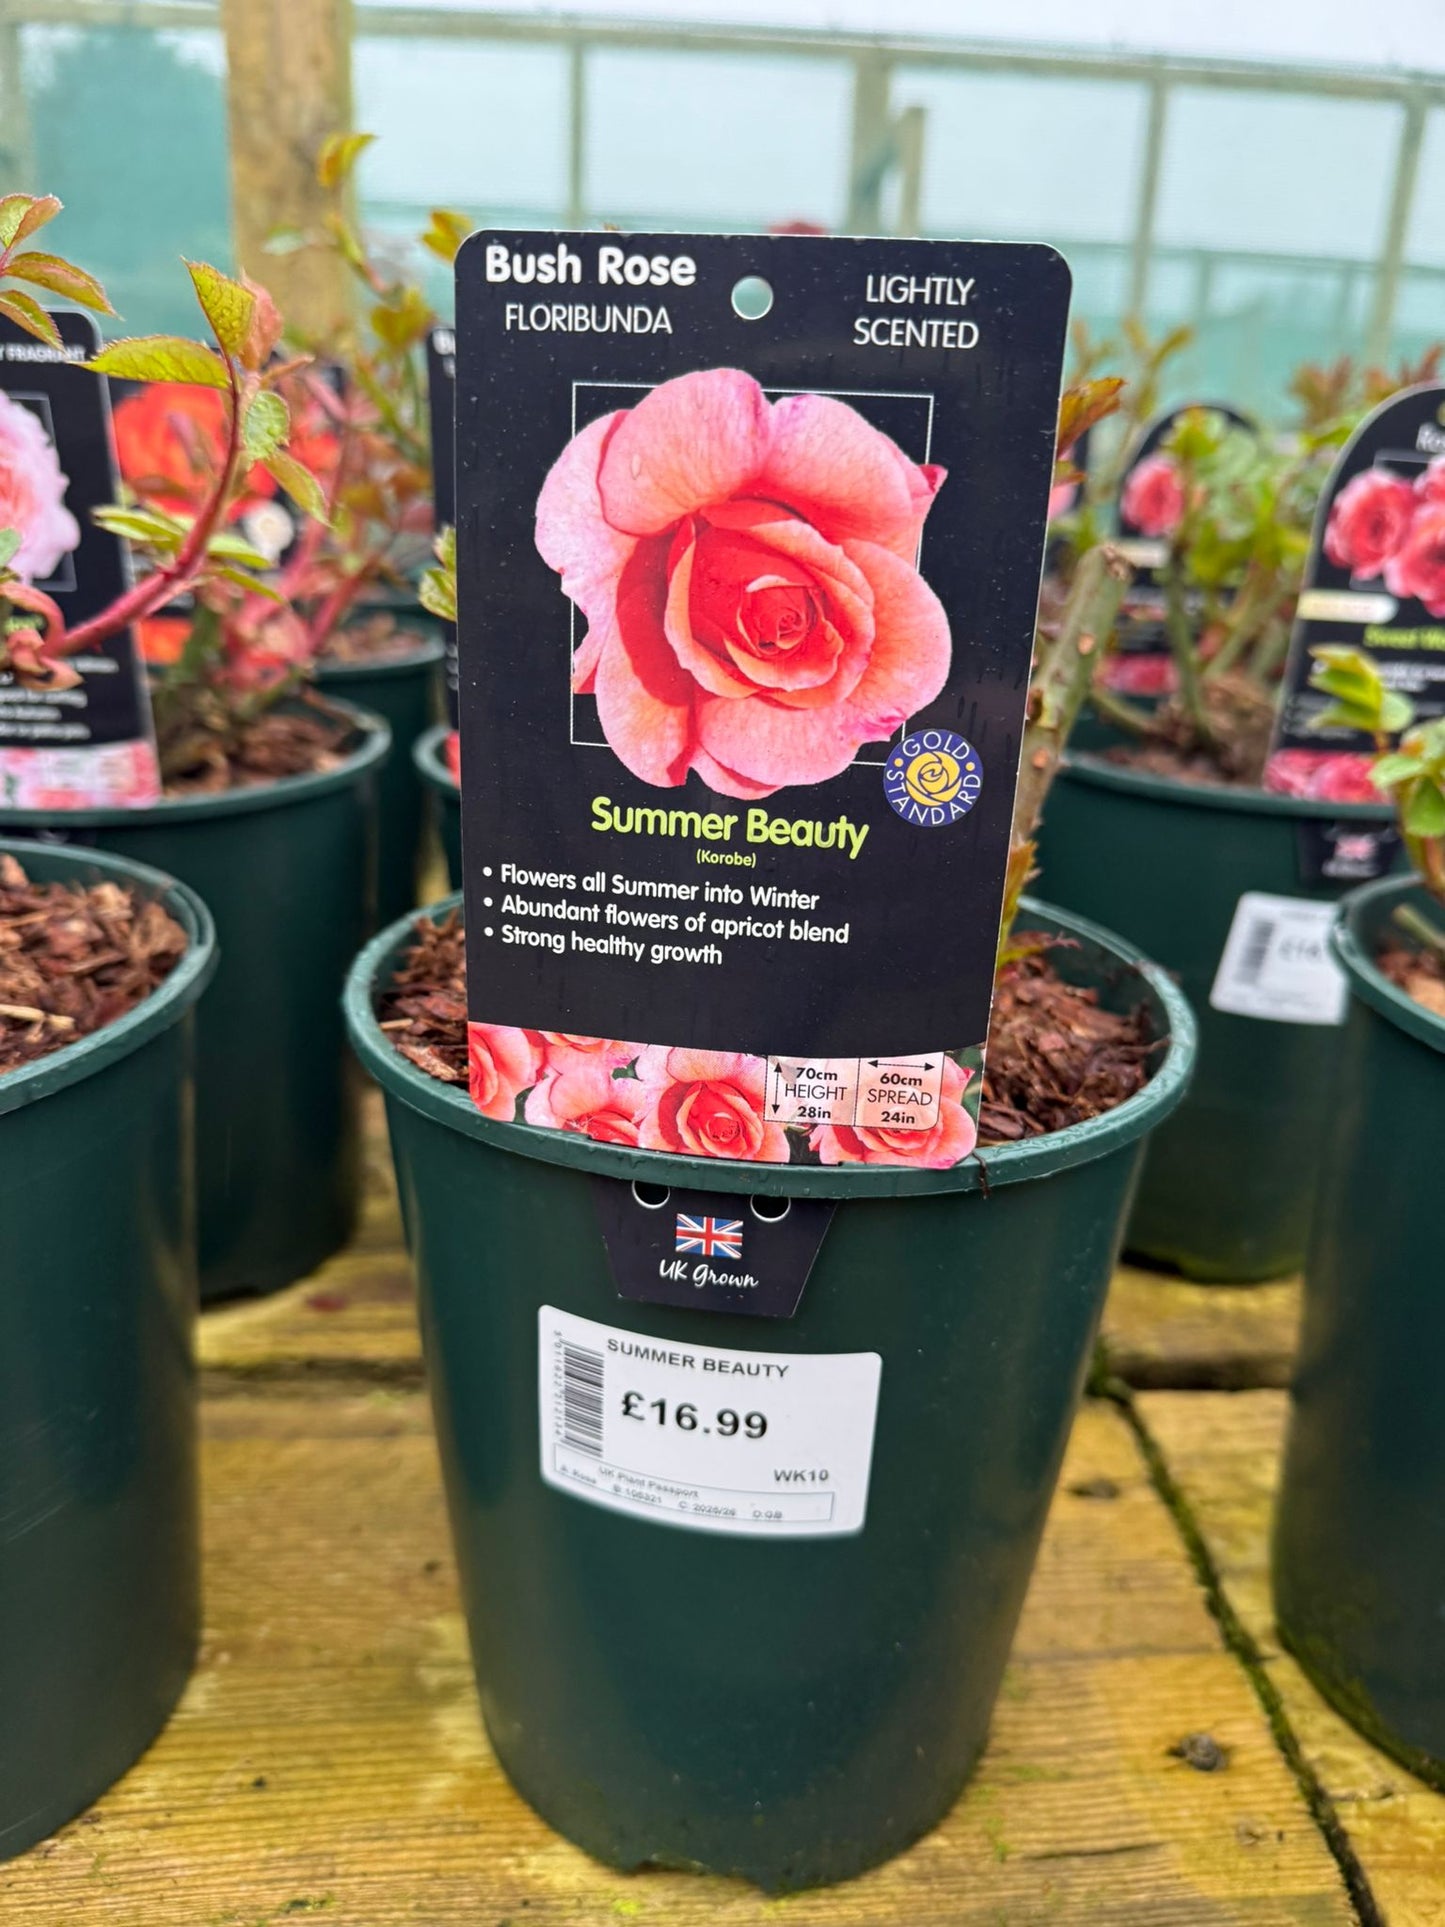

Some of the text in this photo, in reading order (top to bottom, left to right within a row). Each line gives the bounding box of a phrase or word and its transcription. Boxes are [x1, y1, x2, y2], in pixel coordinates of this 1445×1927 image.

[486, 243, 697, 287] Bush Rose
[866, 275, 975, 307] LIGHTLY
[506, 304, 673, 335] FLORIBUNDA
[853, 318, 979, 349] SCENTED
[902, 731, 970, 760] GOLD
[886, 769, 981, 825] STANDARD
[591, 796, 869, 860] Summer Beauty
[696, 849, 756, 868] (Korobe)
[501, 863, 820, 911] Flowers all Summer into Winter
[501, 894, 850, 944] Abundant flowers of apricot blend
[501, 923, 723, 965] Strong healthy growth
[796, 1067, 838, 1082] 70cm
[880, 1072, 923, 1087] 60cm
[785, 1083, 848, 1101] HEIGHT
[867, 1088, 933, 1106] SPREAD
[798, 1105, 831, 1120] 28in
[881, 1110, 916, 1125] 24in
[658, 1258, 759, 1288] UK Grown
[607, 1338, 789, 1379] SUMMER BEAUTY
[621, 1389, 768, 1440] £16.99
[599, 1465, 699, 1498] UK Plant Passport
[774, 1469, 829, 1482] WK10
